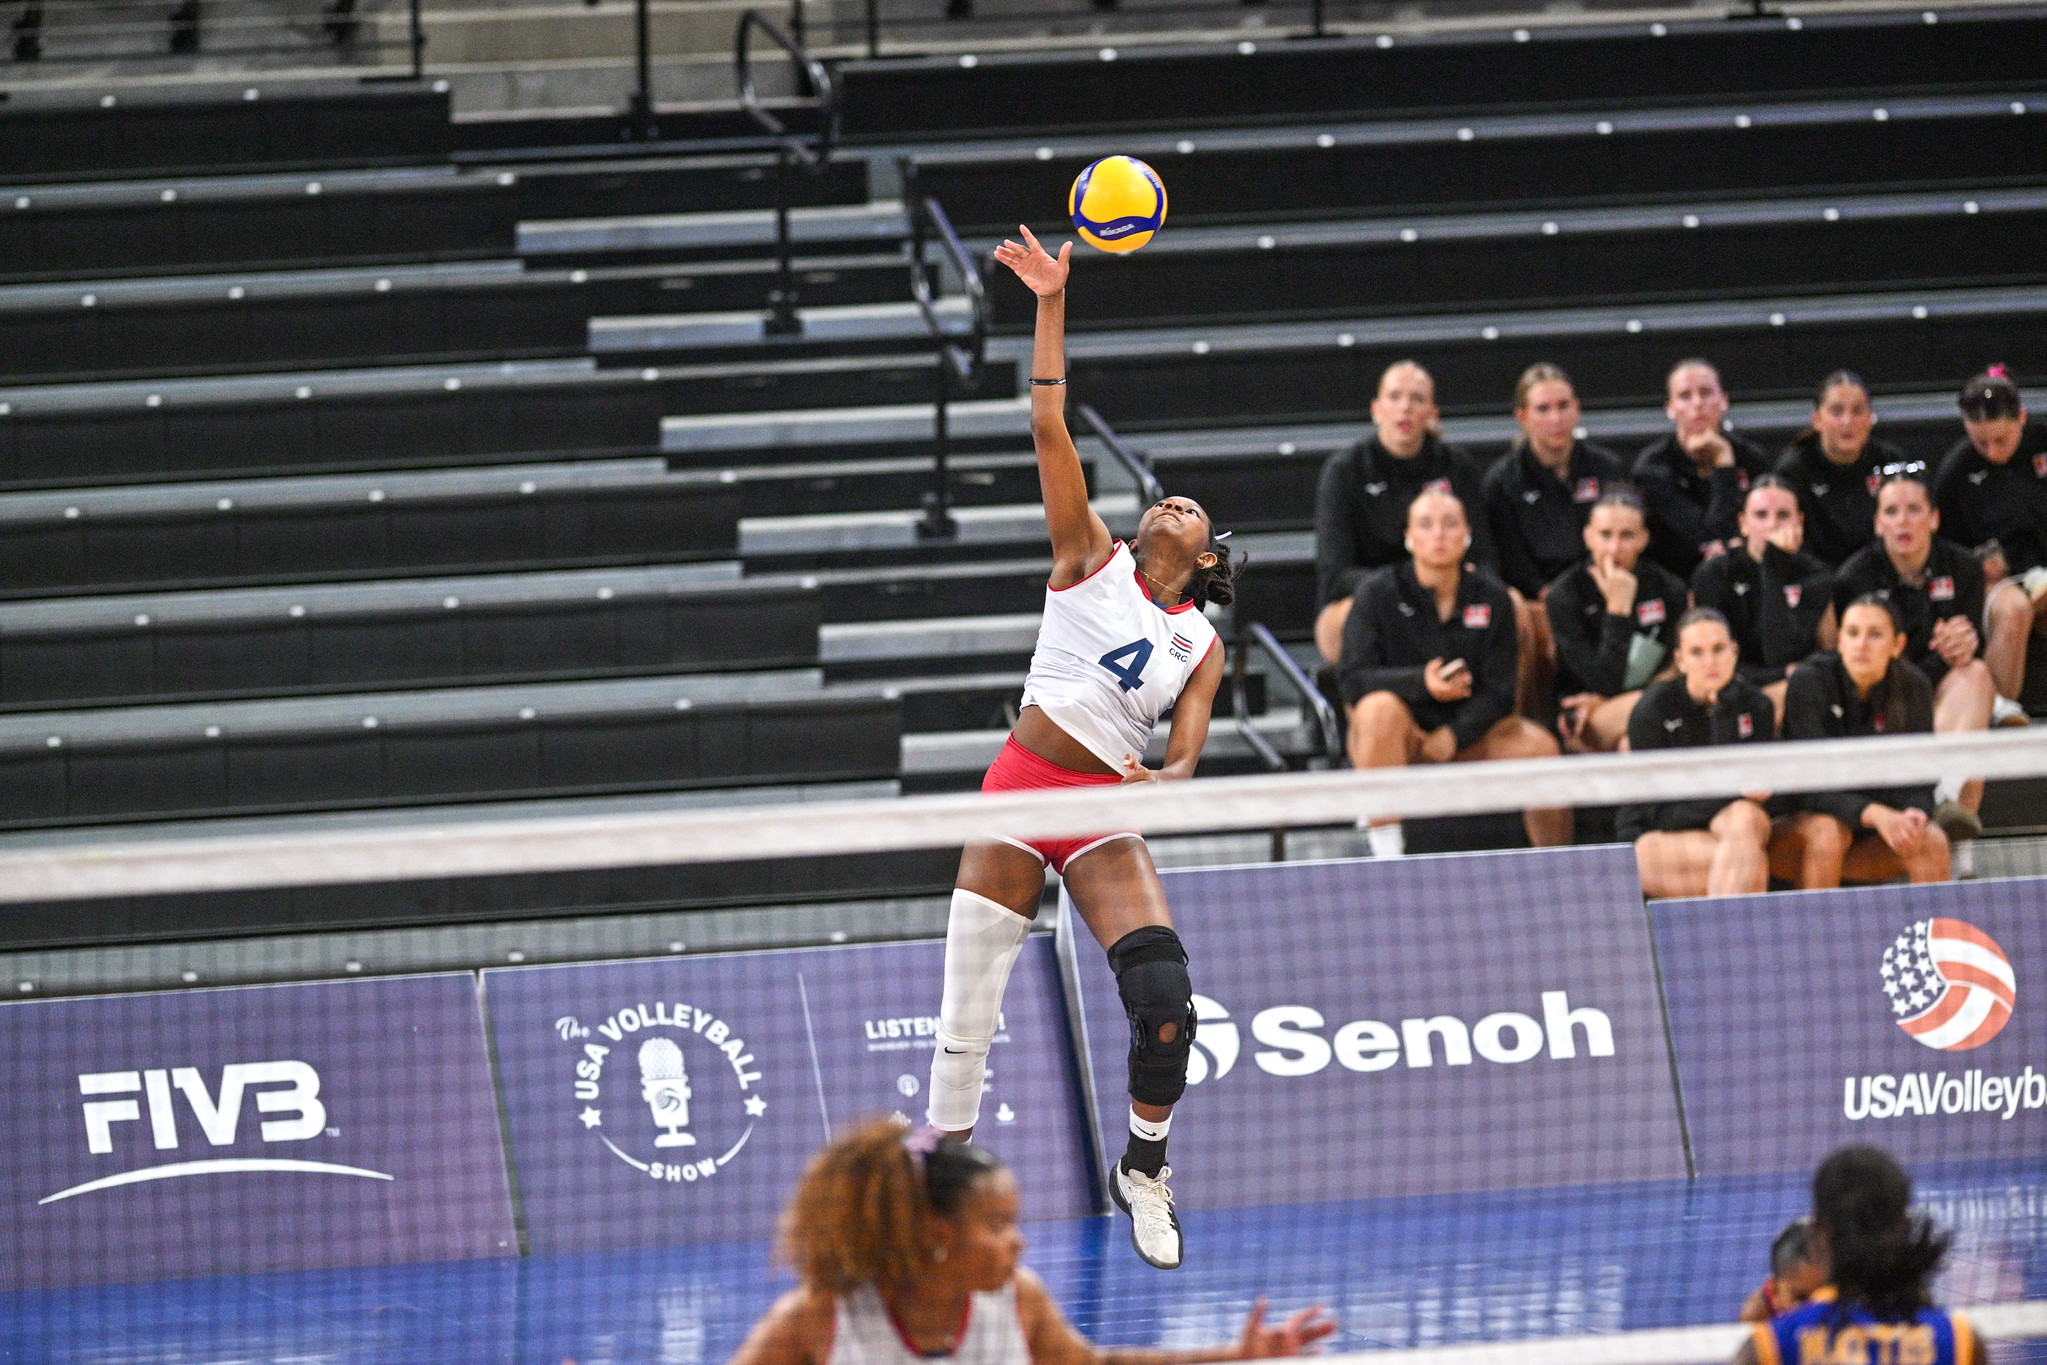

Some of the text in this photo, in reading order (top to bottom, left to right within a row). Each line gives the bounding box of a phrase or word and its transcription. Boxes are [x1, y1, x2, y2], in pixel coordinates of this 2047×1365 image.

[1098, 638, 1154, 693] 4
[1169, 647, 1188, 663] CRC
[555, 1016, 591, 1041] The
[575, 1001, 762, 1101] USA VOLLEYBALL
[1252, 991, 1615, 1076] Senoh
[79, 1060, 326, 1154] FIVB
[1844, 1065, 2047, 1120] USAVolleyb
[649, 1157, 717, 1183] SHOW
